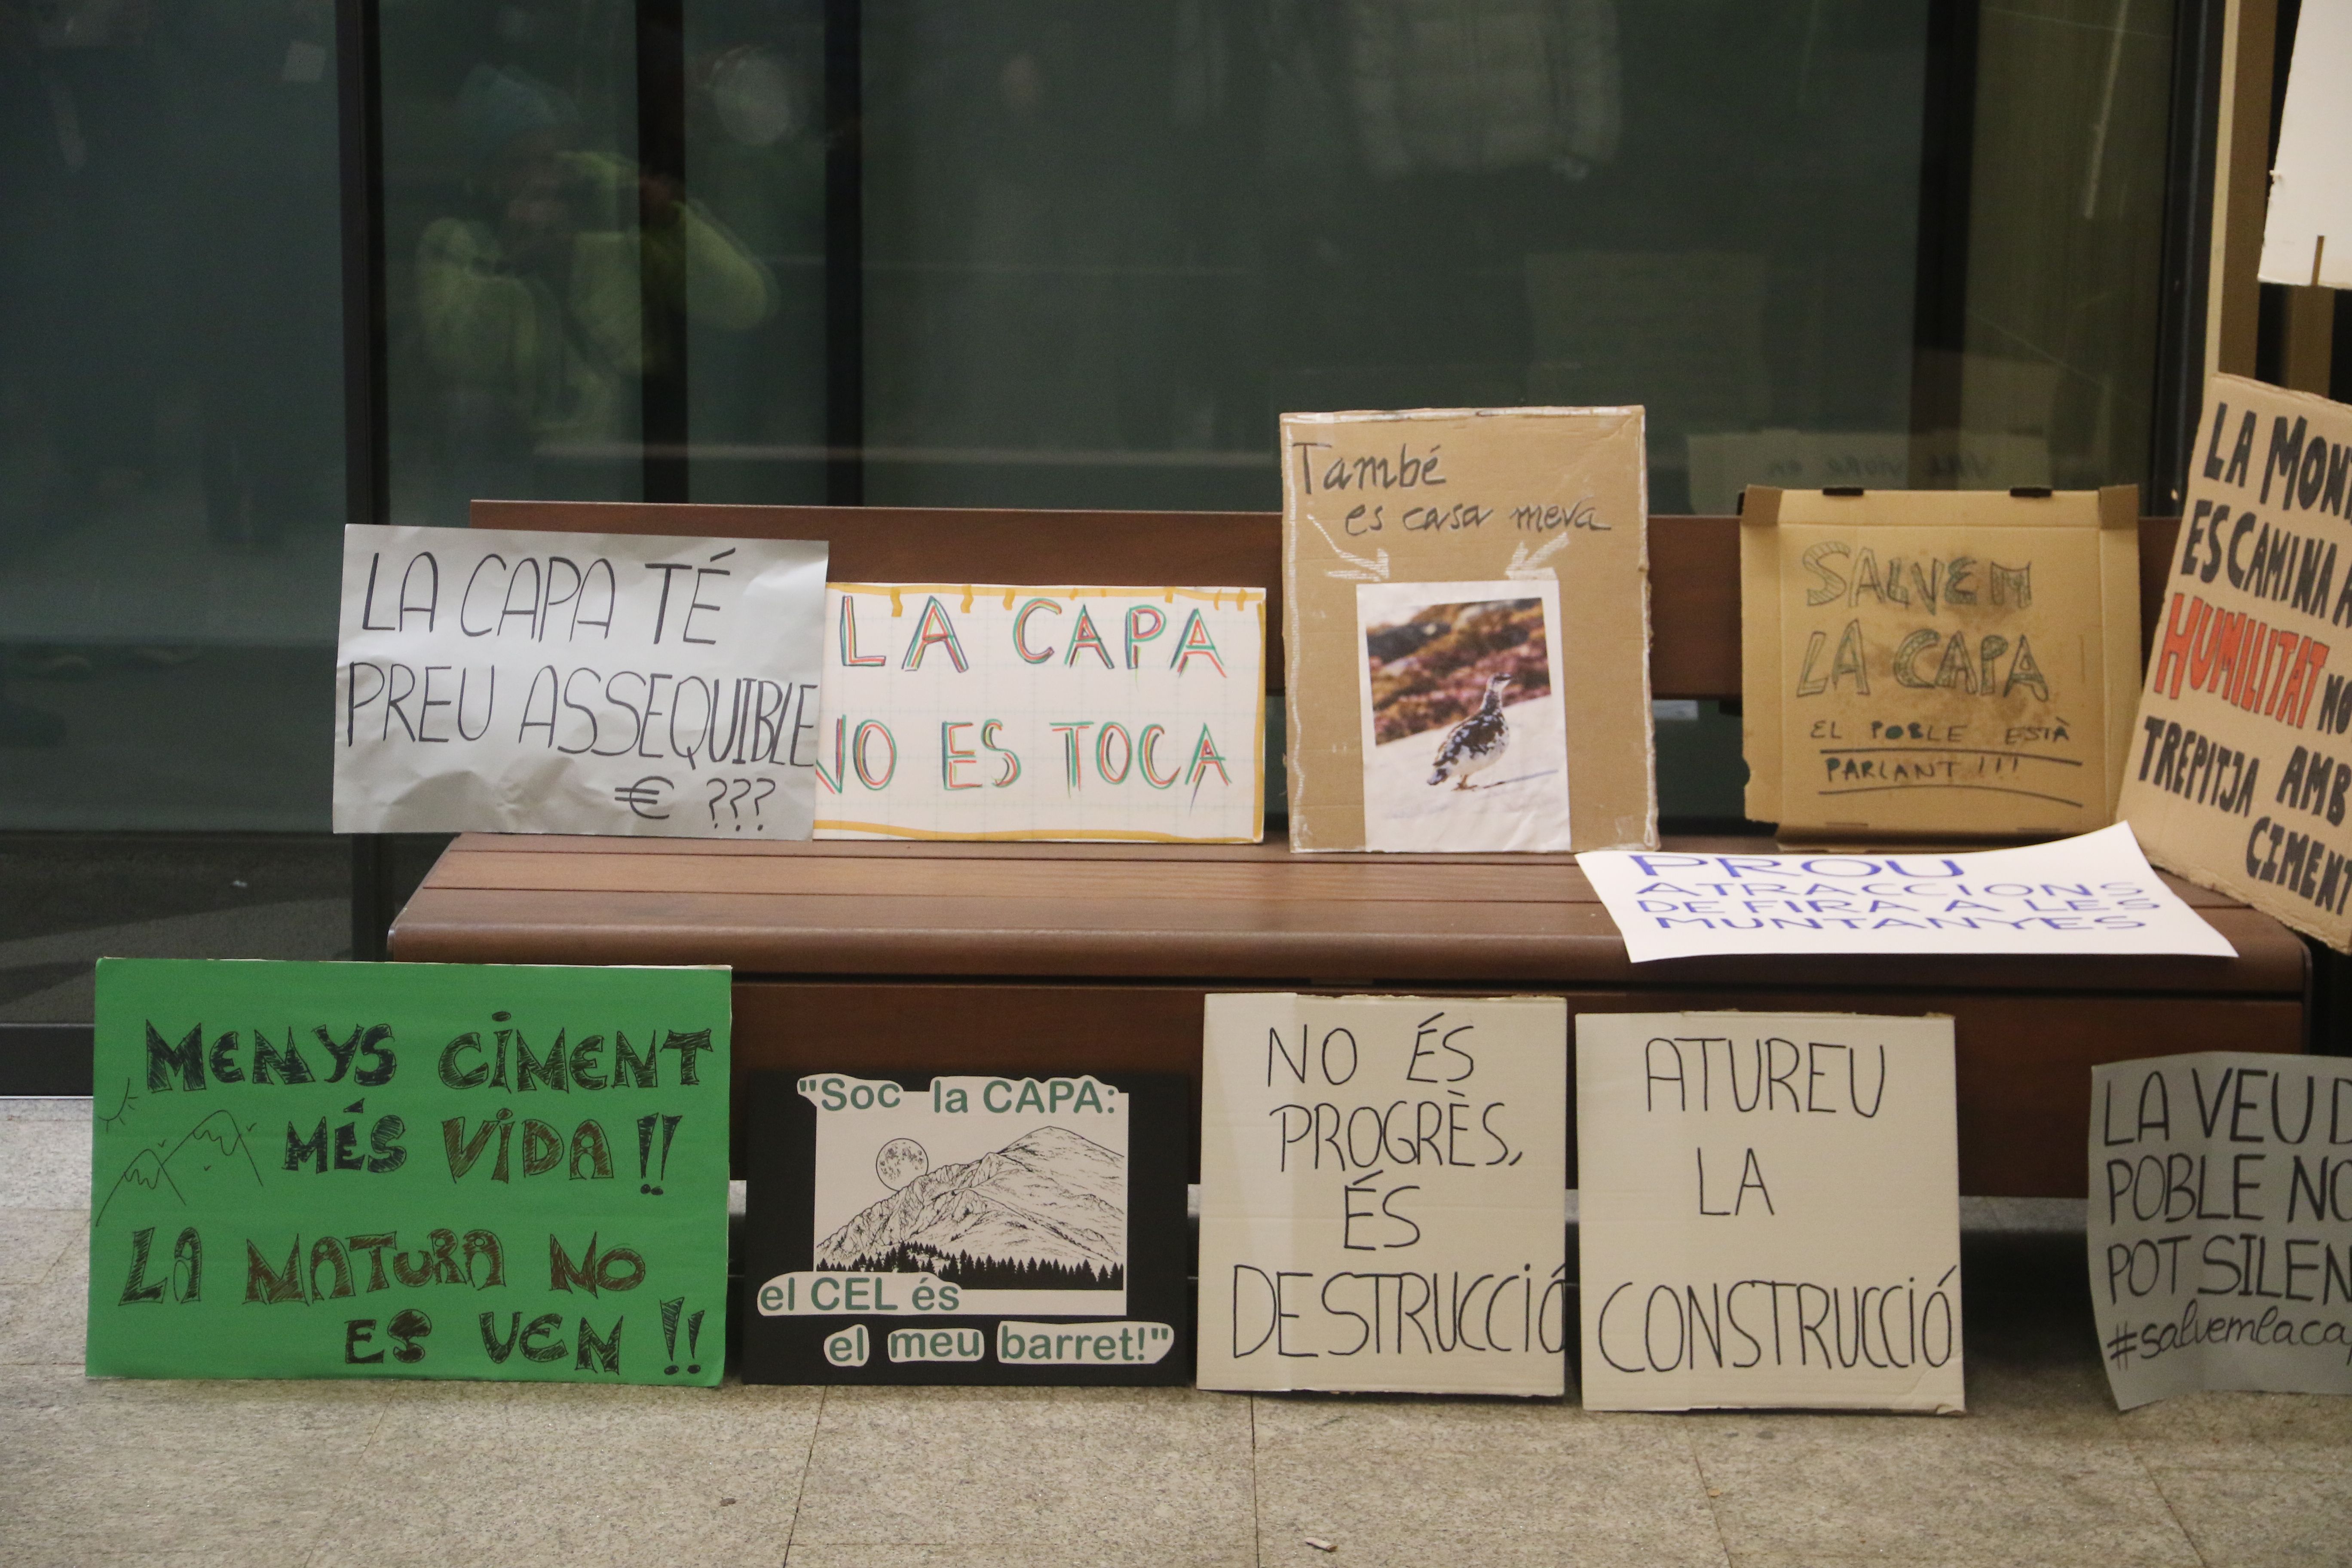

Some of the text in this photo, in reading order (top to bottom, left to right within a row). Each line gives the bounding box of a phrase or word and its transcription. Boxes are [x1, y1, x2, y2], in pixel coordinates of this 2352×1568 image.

[1292, 443, 1446, 494] També
[2203, 402, 2352, 524] LA MON
[1345, 496, 1611, 536] es casa meva
[361, 548, 736, 645] LA CAPA TÉ
[1802, 540, 2032, 616] SALVEM
[840, 595, 1227, 679] LA CAPA
[1796, 618, 2049, 702] LA CAPA
[2154, 592, 2330, 729] HUMILITAT
[348, 662, 818, 770] PREU ASSEQUIBLE
[1810, 720, 1842, 739] EL
[1871, 721, 1968, 742] POBLE
[942, 719, 1021, 790] ES
[1049, 721, 1232, 812] TOCA
[2138, 716, 2352, 827] TREPITJA AMB
[614, 776, 776, 832] € ???
[1628, 854, 1964, 877] PROU
[1635, 882, 2144, 897] ATRACCIONS
[1636, 898, 2161, 914] DE FIRA A LES
[1656, 916, 2146, 930] MUNTANYES
[146, 1019, 397, 1093] MENYS
[1268, 1012, 1474, 1087] NO ÉS
[1645, 1038, 1885, 1118] ATUREU
[798, 1077, 1116, 1115] "Soc la CAPA:
[1269, 1090, 1523, 1172] PROGRÈS,
[2104, 1070, 2170, 1147] LA
[2192, 1067, 2314, 1145] VEU
[281, 1097, 407, 1175] MÉS
[1344, 1170, 1421, 1250] ÉS
[1697, 1147, 1774, 1216] LA
[2106, 1152, 2266, 1226] POBLE
[117, 1227, 646, 1307] LA NATURA NO
[759, 1277, 961, 1312] el CEL és
[2107, 1235, 2192, 1305] POT
[344, 1308, 432, 1364] ES
[478, 1311, 621, 1375] VEN
[829, 1325, 1169, 1362] el meu barret!"
